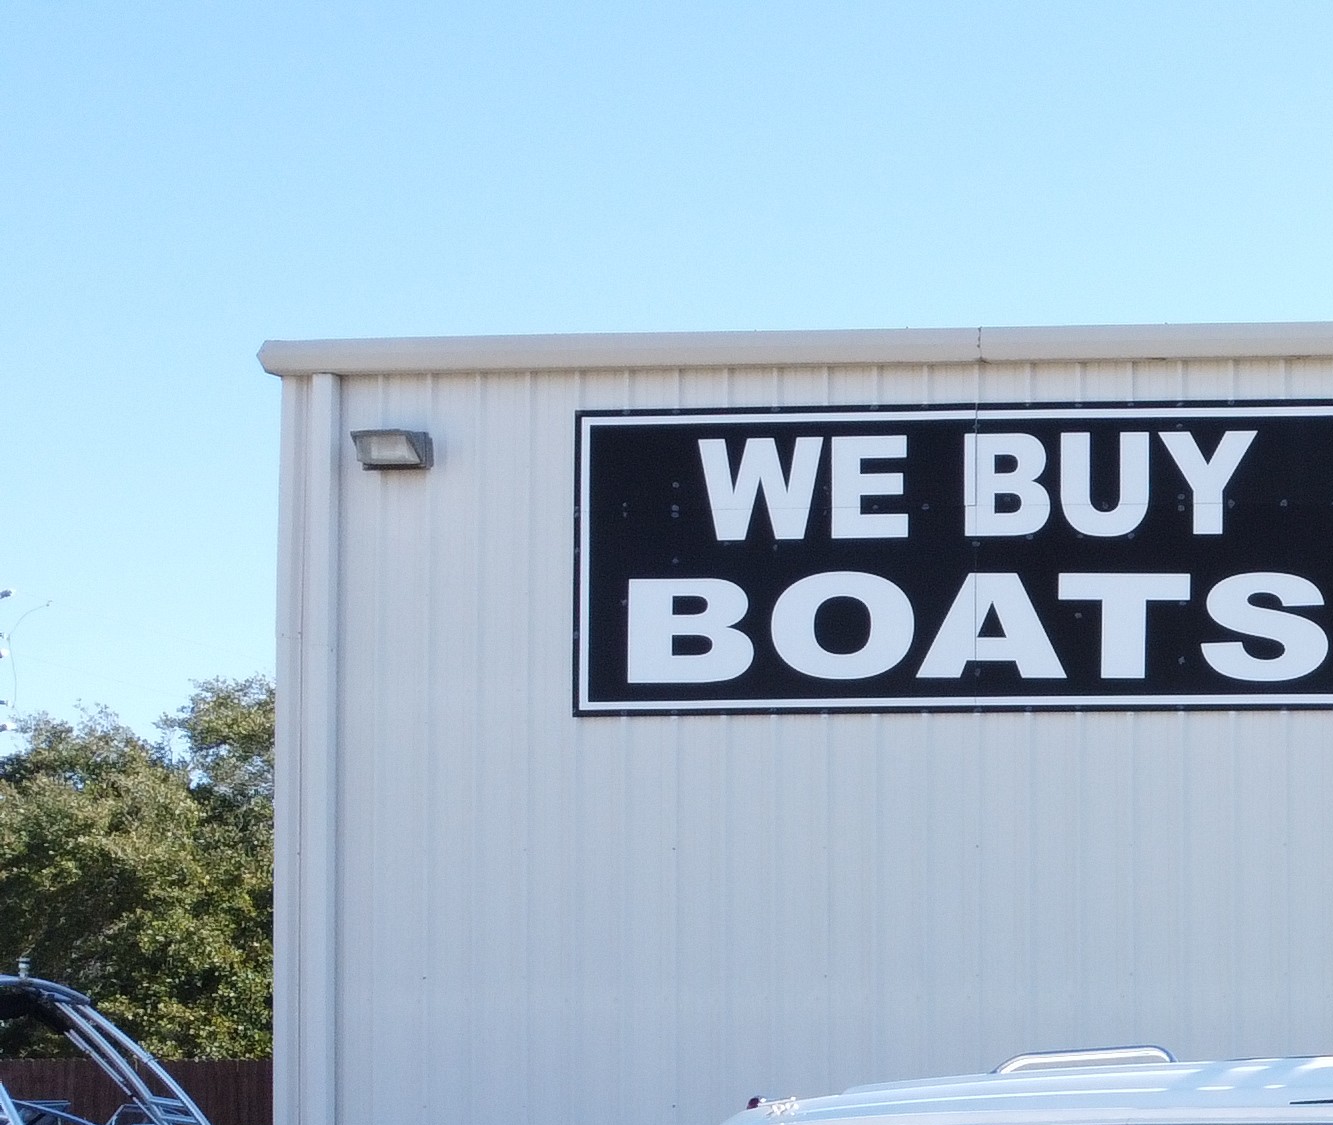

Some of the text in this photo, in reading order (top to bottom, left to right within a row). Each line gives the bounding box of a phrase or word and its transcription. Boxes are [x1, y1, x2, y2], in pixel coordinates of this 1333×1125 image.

[697, 429, 1259, 542] WE BUY
[626, 570, 1330, 684] BOATS
